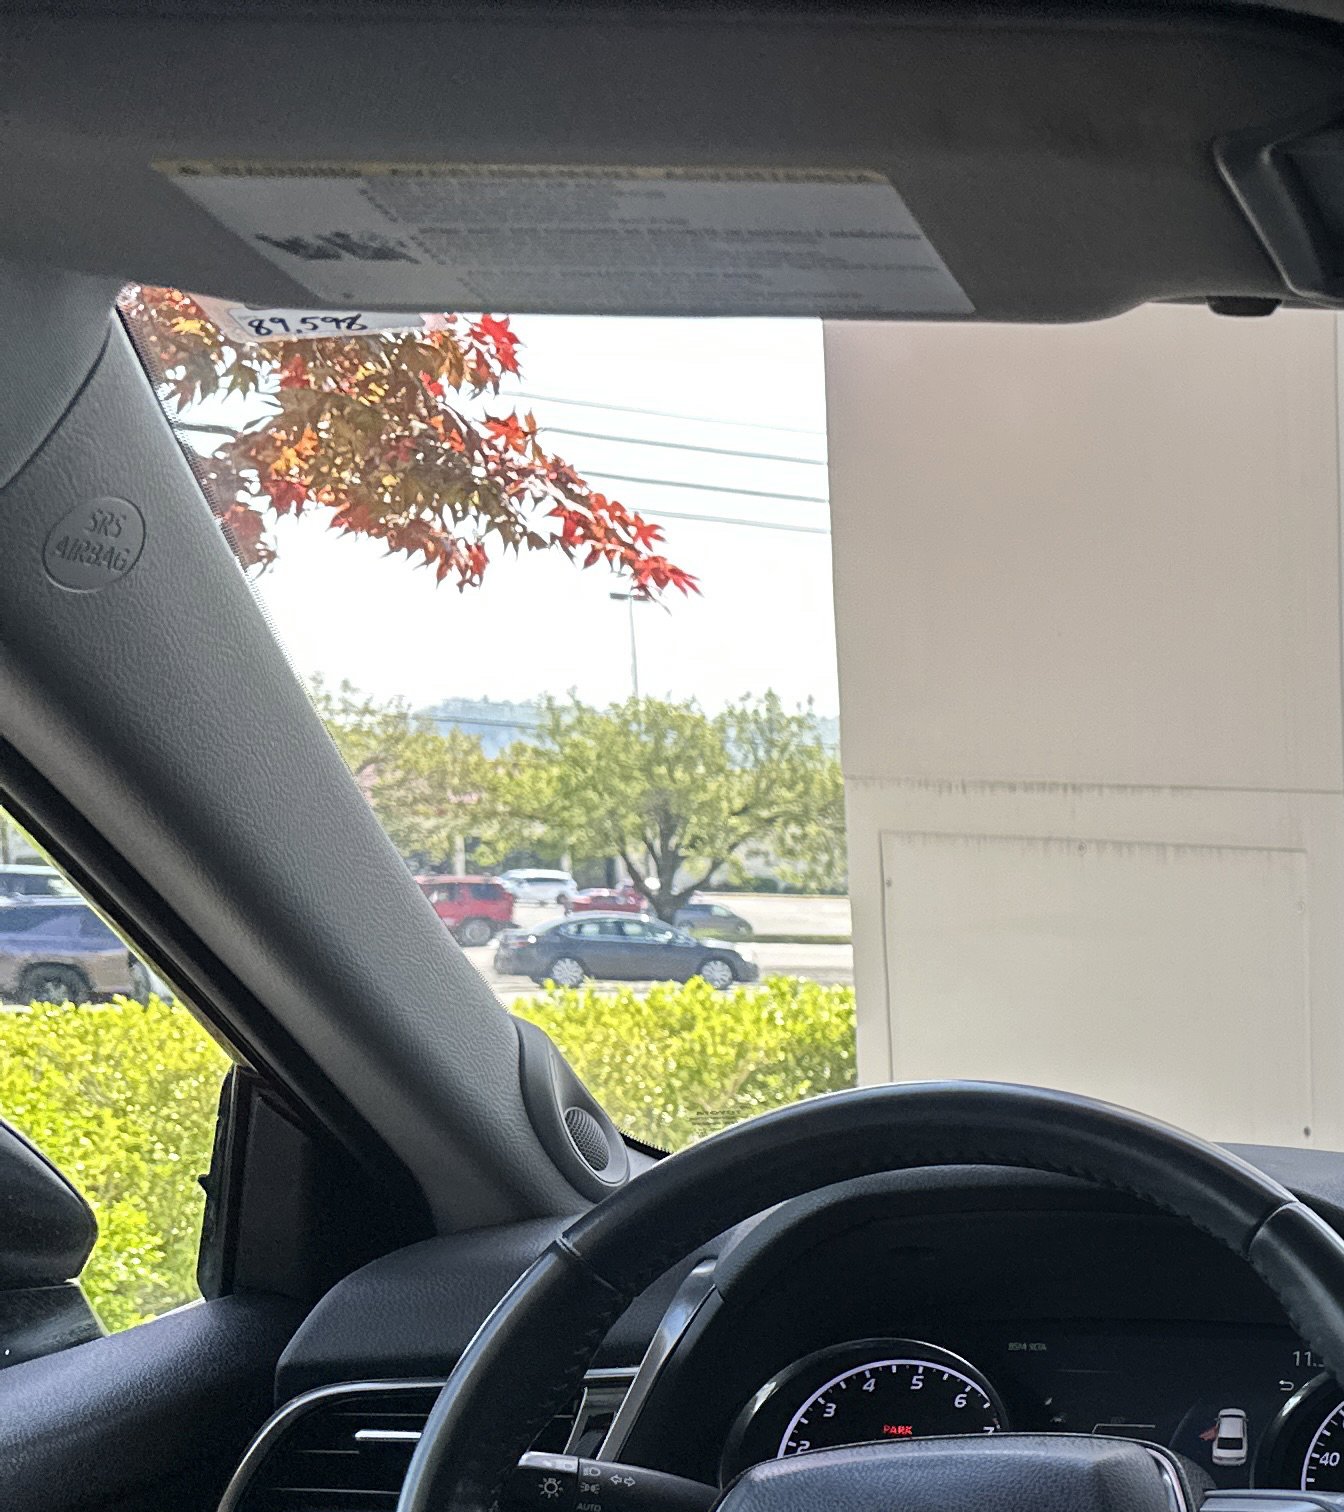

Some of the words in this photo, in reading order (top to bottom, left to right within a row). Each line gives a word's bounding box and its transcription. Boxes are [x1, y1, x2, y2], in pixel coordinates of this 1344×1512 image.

[84, 508, 127, 539] SRS
[54, 535, 131, 572] AIRBAG
[862, 1378, 876, 1393] 4
[910, 1375, 924, 1390] 5
[954, 1394, 968, 1409] 6
[823, 1402, 837, 1418] 3
[883, 1424, 913, 1436] PARK
[1319, 1452, 1341, 1467] 40
[576, 1502, 602, 1512] AUTO
